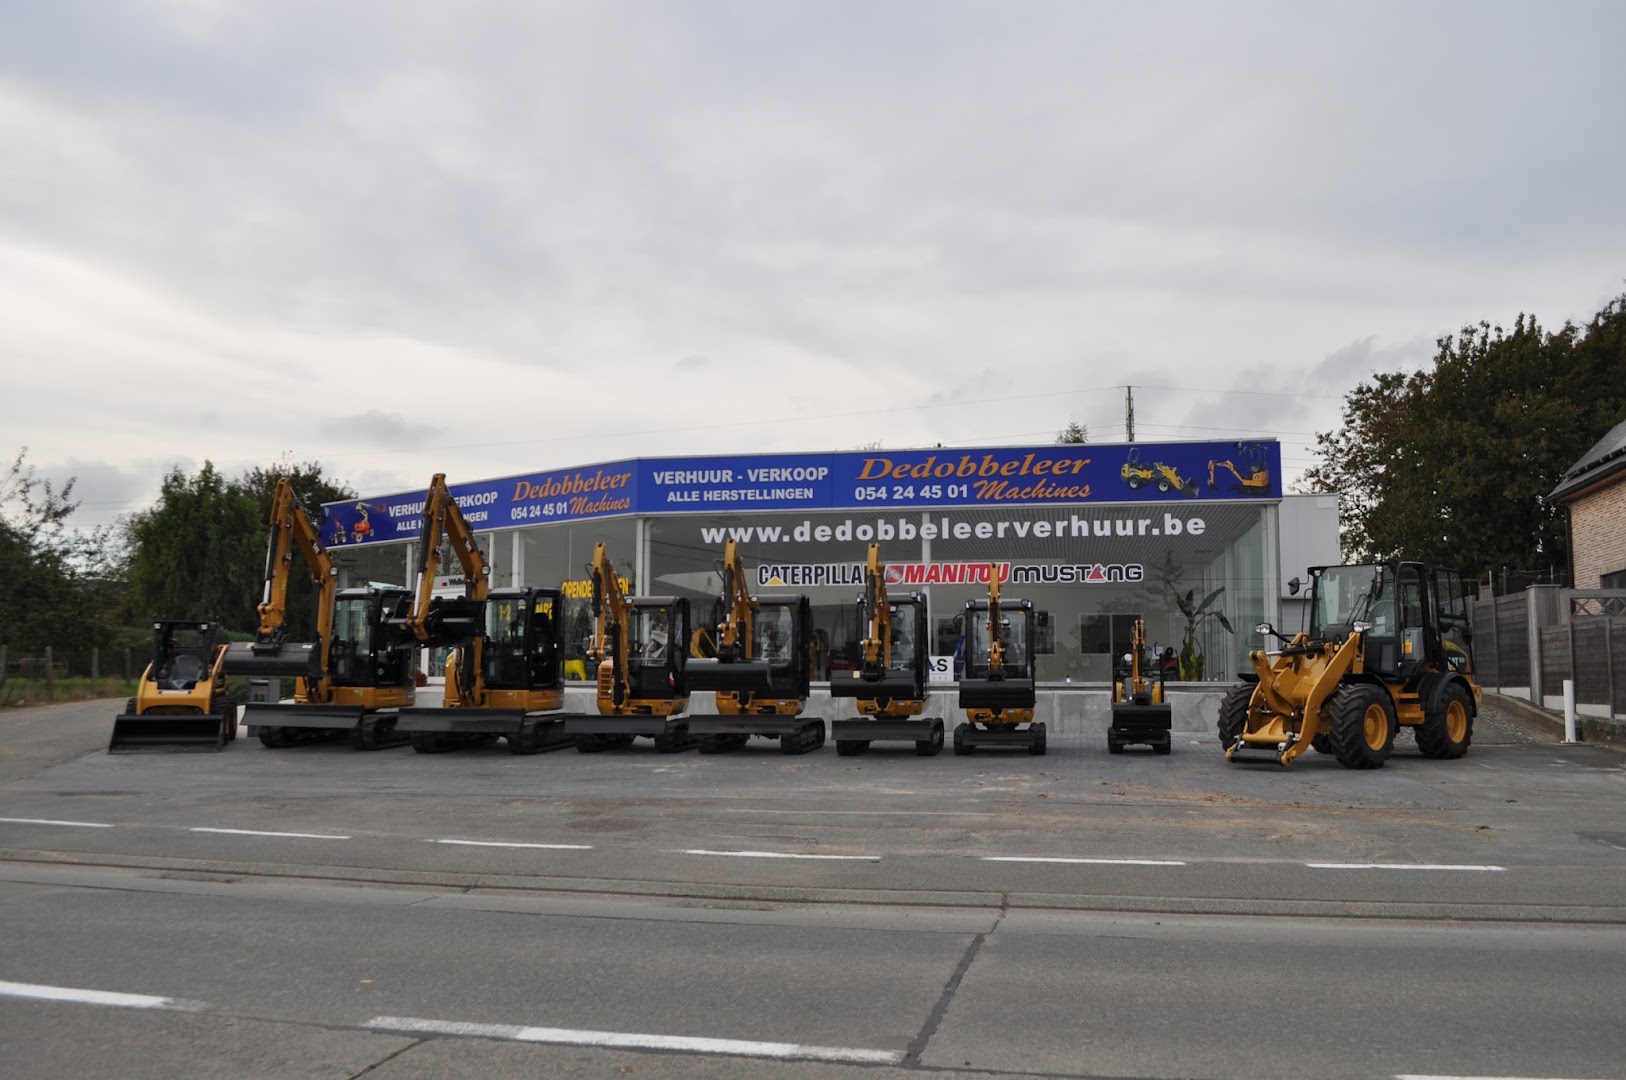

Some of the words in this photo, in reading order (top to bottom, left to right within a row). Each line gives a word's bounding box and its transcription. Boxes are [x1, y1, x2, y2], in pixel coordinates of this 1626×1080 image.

[653, 470, 733, 485] VERHUUR
[747, 467, 829, 483] VERKOOP
[855, 453, 1091, 481] Dedobbeleer
[511, 470, 632, 502] Dedobbeleer
[667, 491, 700, 502] ALLE
[703, 488, 814, 501] HERSTELLINGEN
[855, 487, 887, 501] 054
[893, 486, 915, 500] 24
[920, 485, 942, 499] 45
[947, 484, 968, 498] 01
[973, 479, 1092, 500] Machines
[388, 502, 426, 517] VERHU
[454, 491, 498, 508] ERKOOP
[511, 505, 528, 520] 054
[529, 505, 541, 518] 24
[543, 503, 554, 516] 45
[556, 502, 568, 515] 01
[569, 493, 631, 515] Machines
[396, 520, 420, 532] ALLE
[701, 513, 1206, 543] www.dedobbeleerverhuur.be
[758, 565, 868, 585] CATERPILLA
[904, 562, 1010, 584] MANITOU
